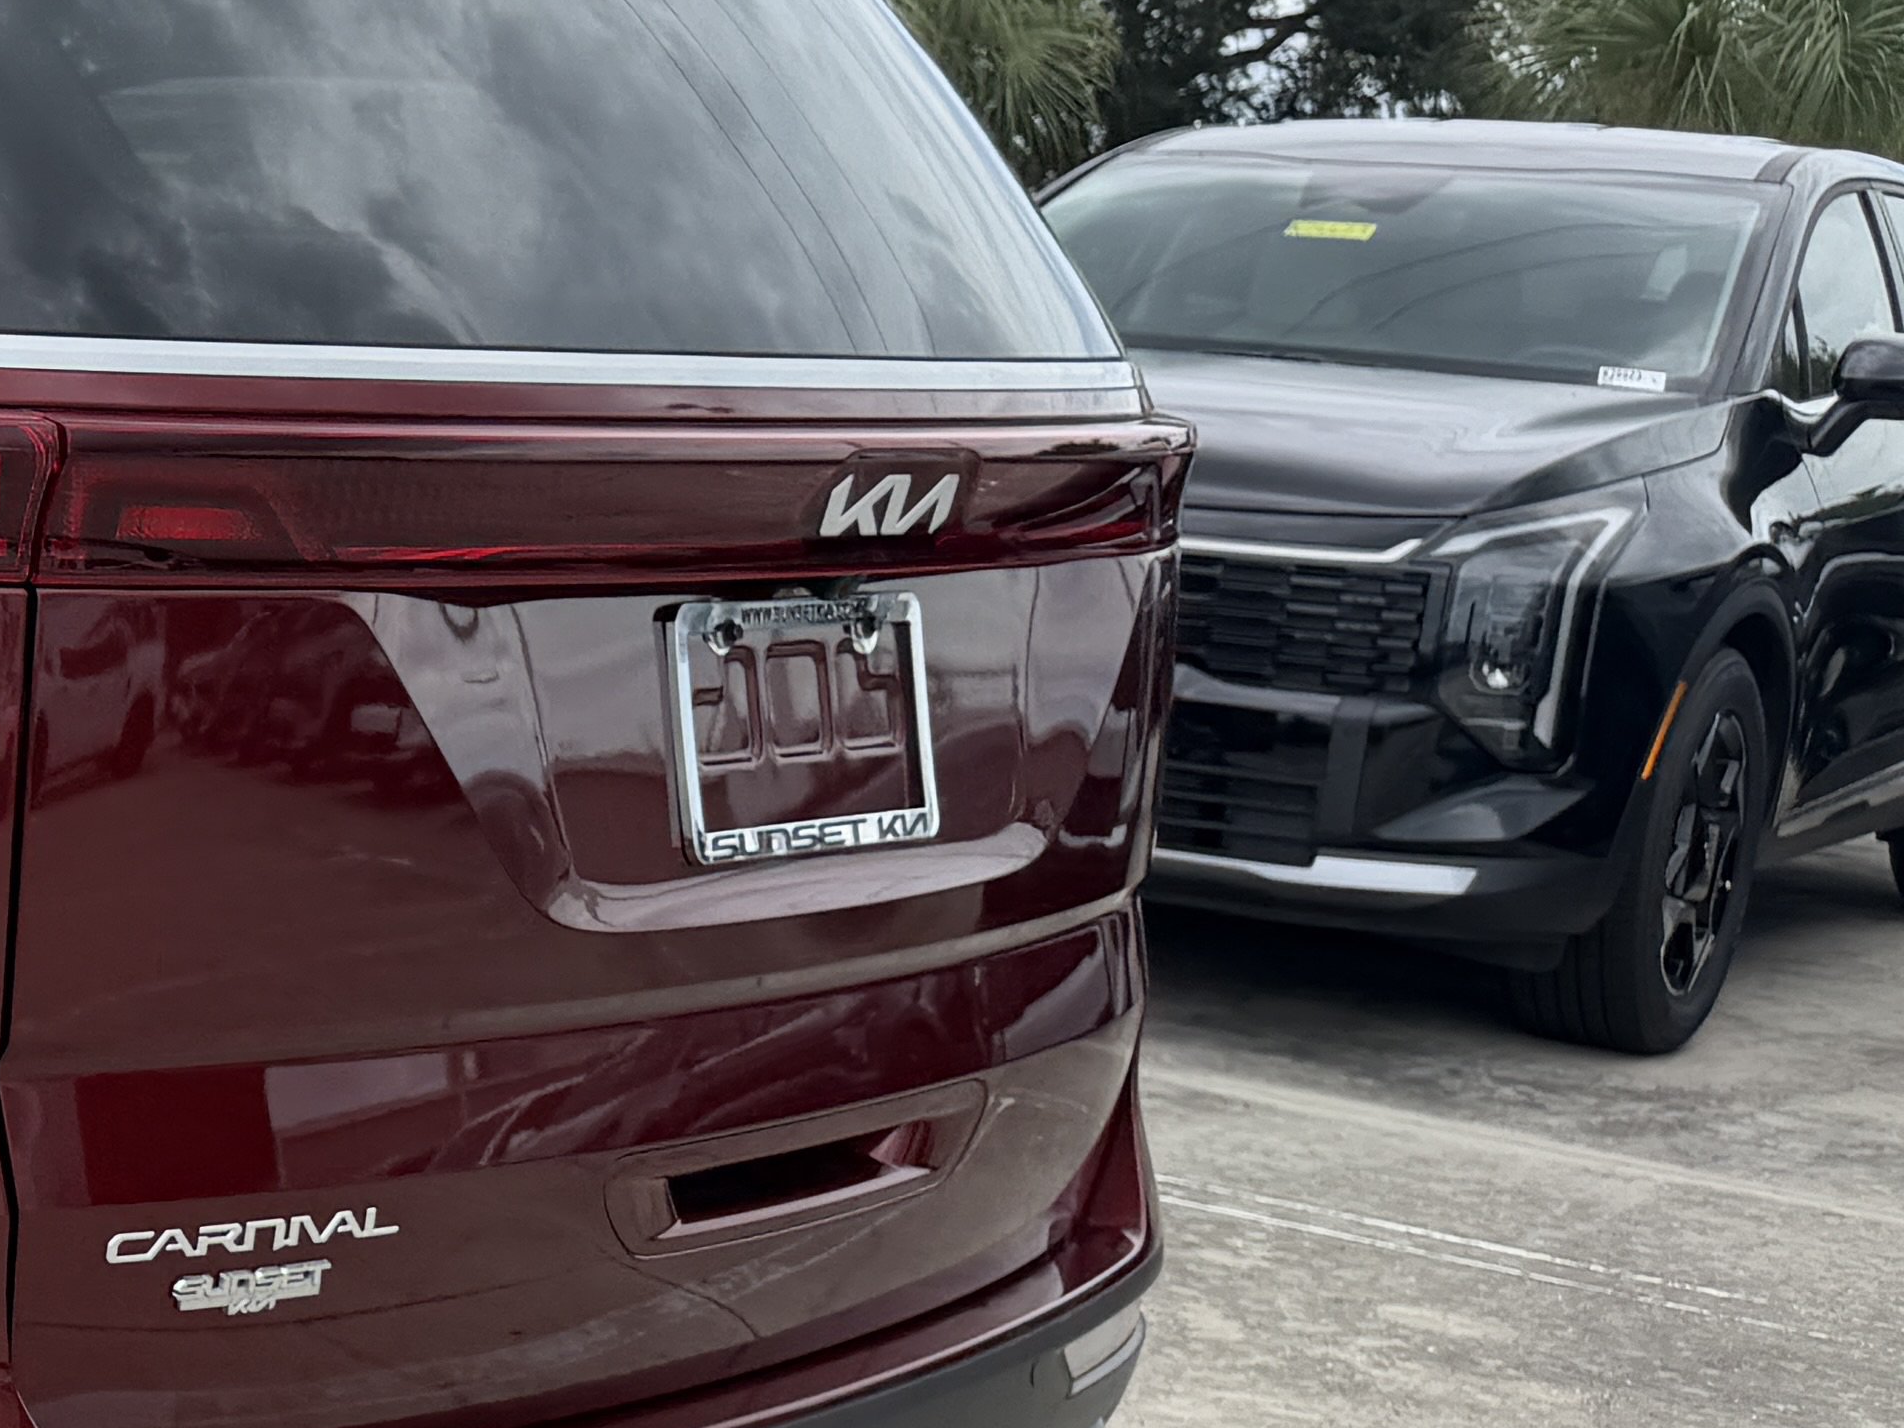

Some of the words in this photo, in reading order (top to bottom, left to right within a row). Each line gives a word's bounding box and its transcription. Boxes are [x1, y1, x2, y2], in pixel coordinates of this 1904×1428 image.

[818, 473, 960, 537] KIA
[711, 818, 868, 862] SUNSET
[877, 812, 929, 839] KIA
[105, 1206, 400, 1264] CARNIVAL
[171, 1258, 333, 1304] SUNSET
